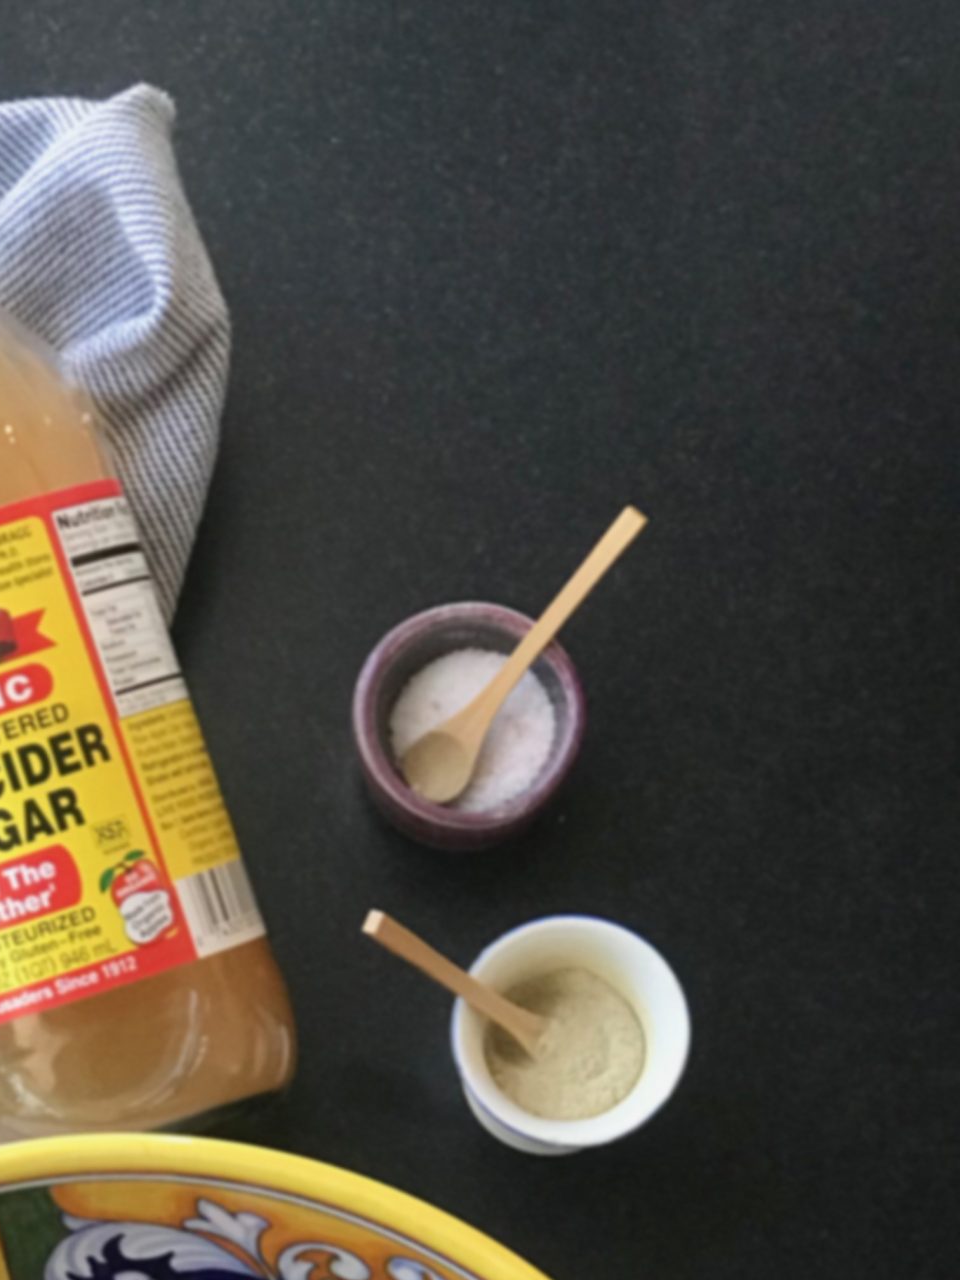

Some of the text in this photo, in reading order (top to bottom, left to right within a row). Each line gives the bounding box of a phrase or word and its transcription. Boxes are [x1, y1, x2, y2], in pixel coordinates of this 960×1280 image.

[2, 861, 57, 890] The
[54, 971, 99, 995] Since
[101, 955, 138, 979] 1912
